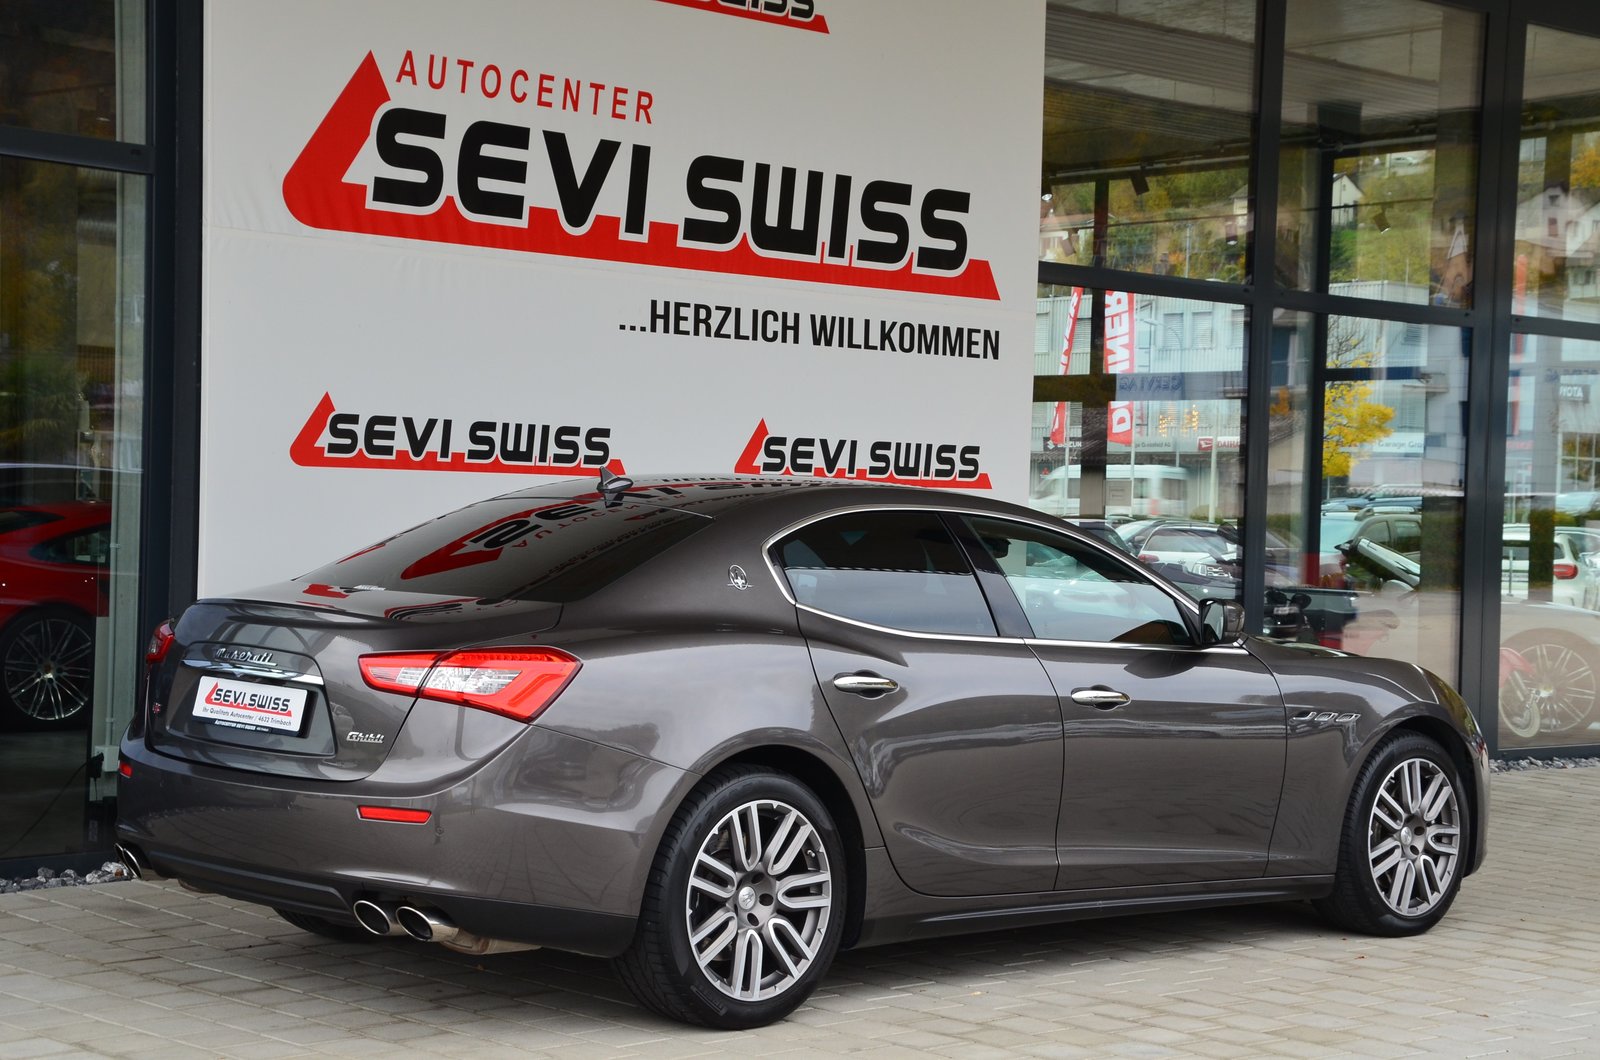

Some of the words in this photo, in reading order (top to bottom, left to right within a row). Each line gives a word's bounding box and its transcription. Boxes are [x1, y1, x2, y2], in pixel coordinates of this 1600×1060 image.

[396, 50, 654, 124] AUTOCENTER
[372, 107, 651, 235] SEVI
[682, 155, 971, 271] SWISS
[810, 313, 1000, 360] WILLKOMMEN
[327, 413, 452, 459] SEVI
[466, 420, 611, 466] SWISS
[762, 436, 857, 476] SEVI
[868, 441, 981, 481] SWISS
[213, 688, 247, 708] SEVI
[248, 693, 290, 712] SWISS
